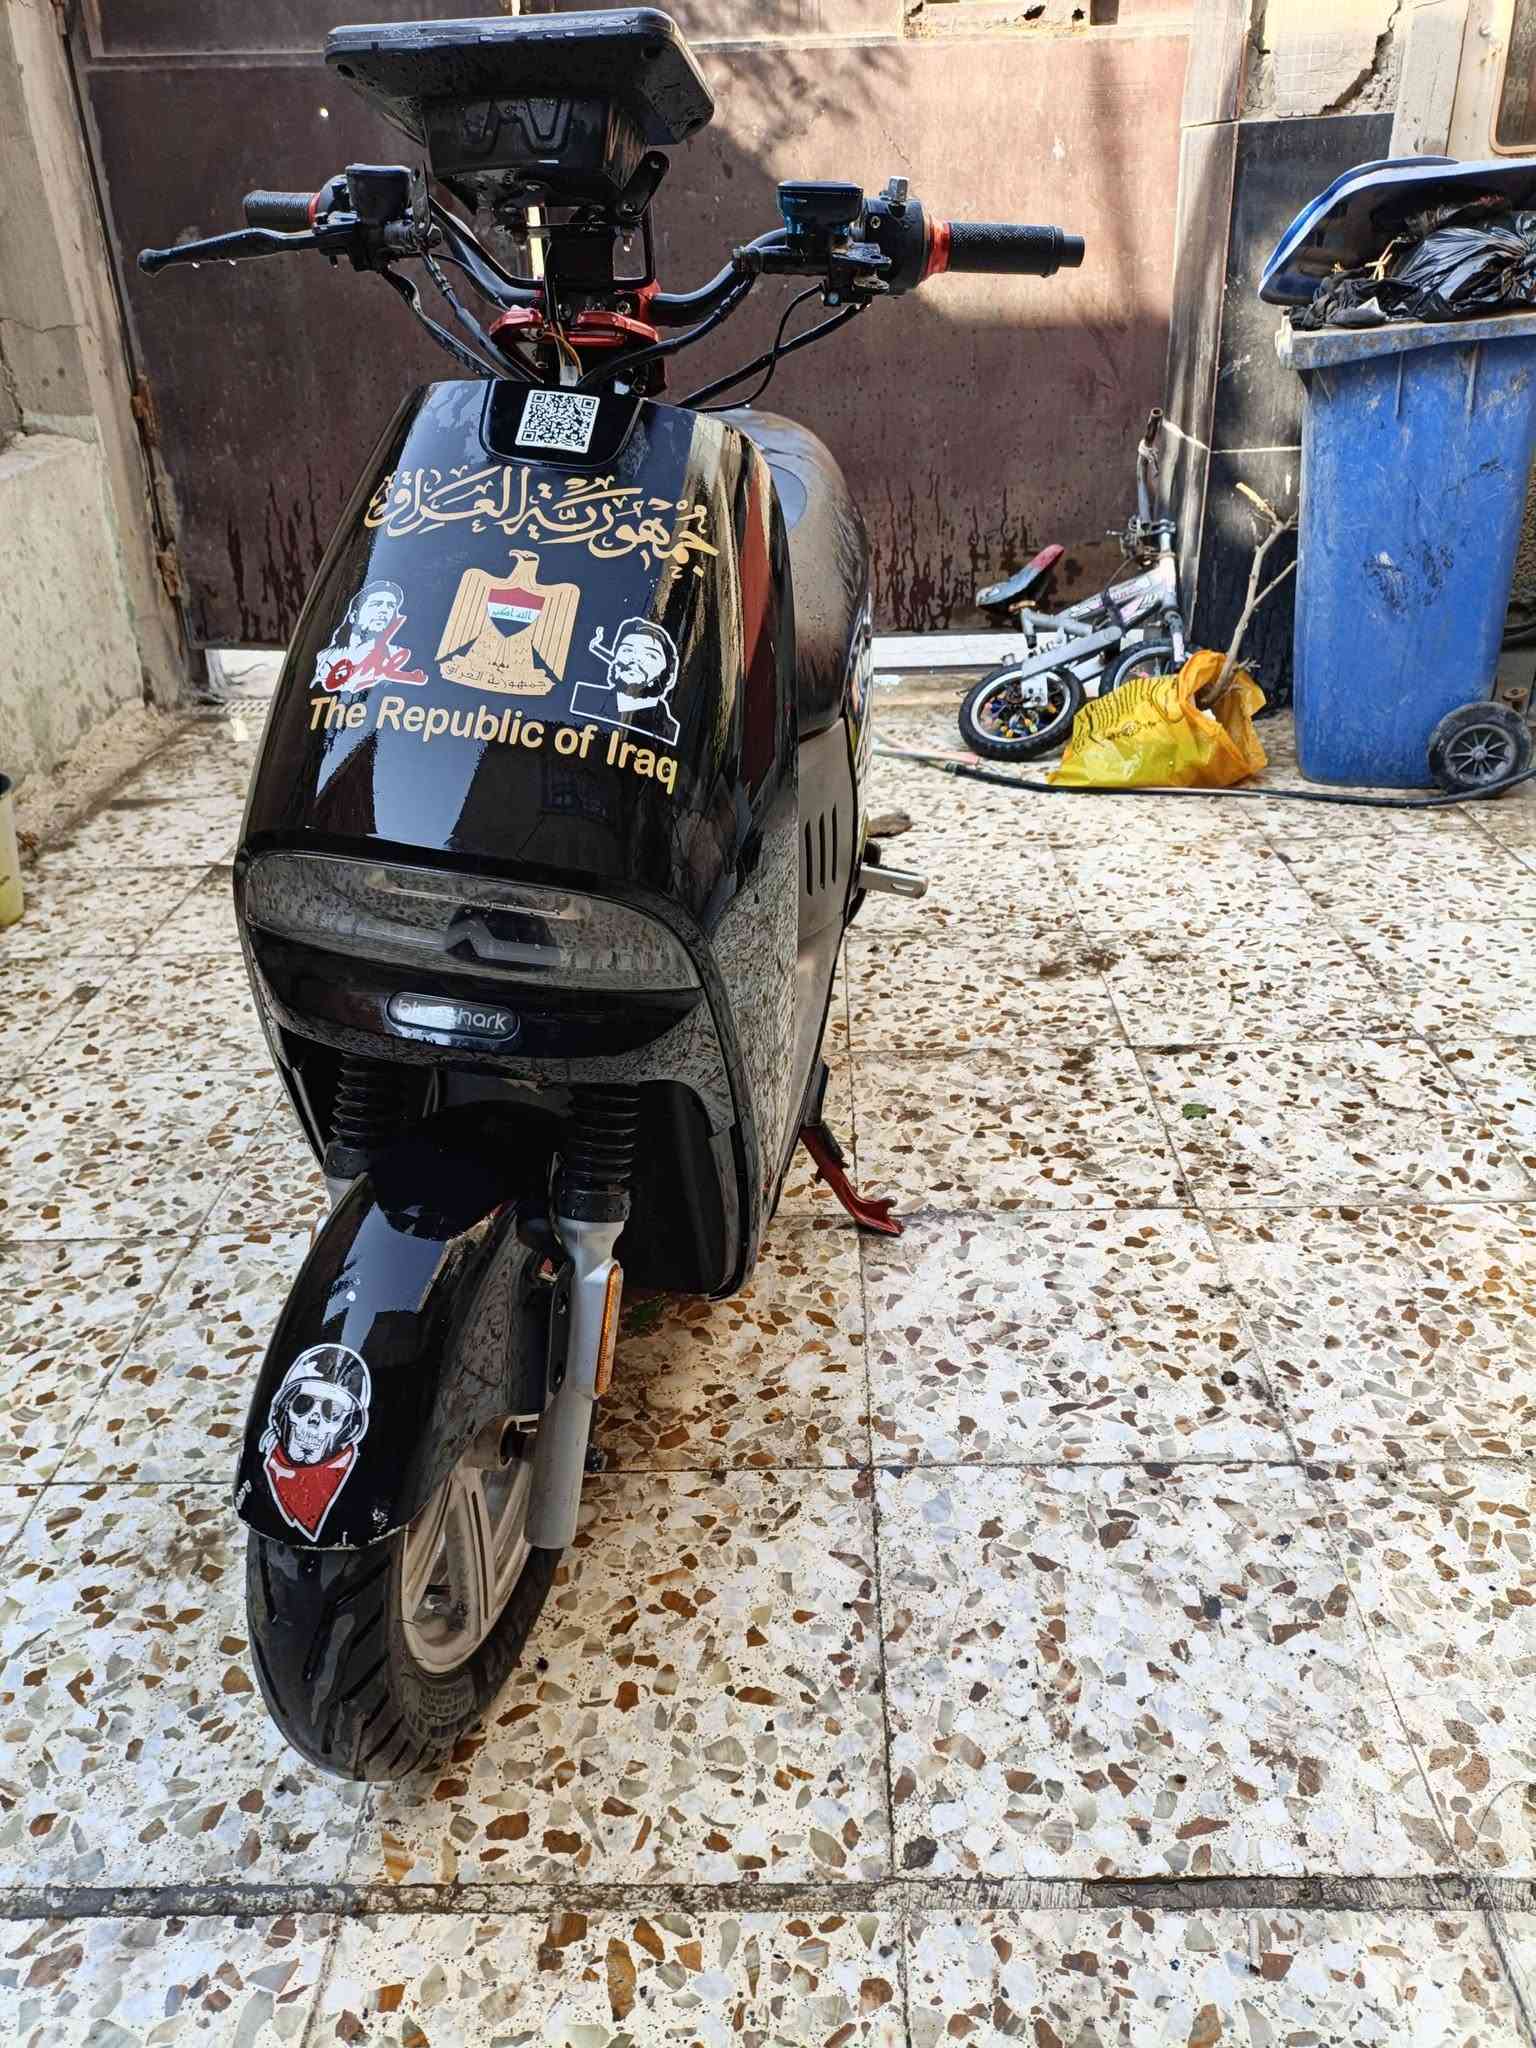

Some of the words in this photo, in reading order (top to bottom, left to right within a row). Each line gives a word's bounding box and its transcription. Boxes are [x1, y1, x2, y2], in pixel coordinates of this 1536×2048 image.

[310, 695, 367, 731] The
[376, 696, 544, 748] Republic
[554, 724, 598, 759] of
[606, 730, 678, 795] Iraq
